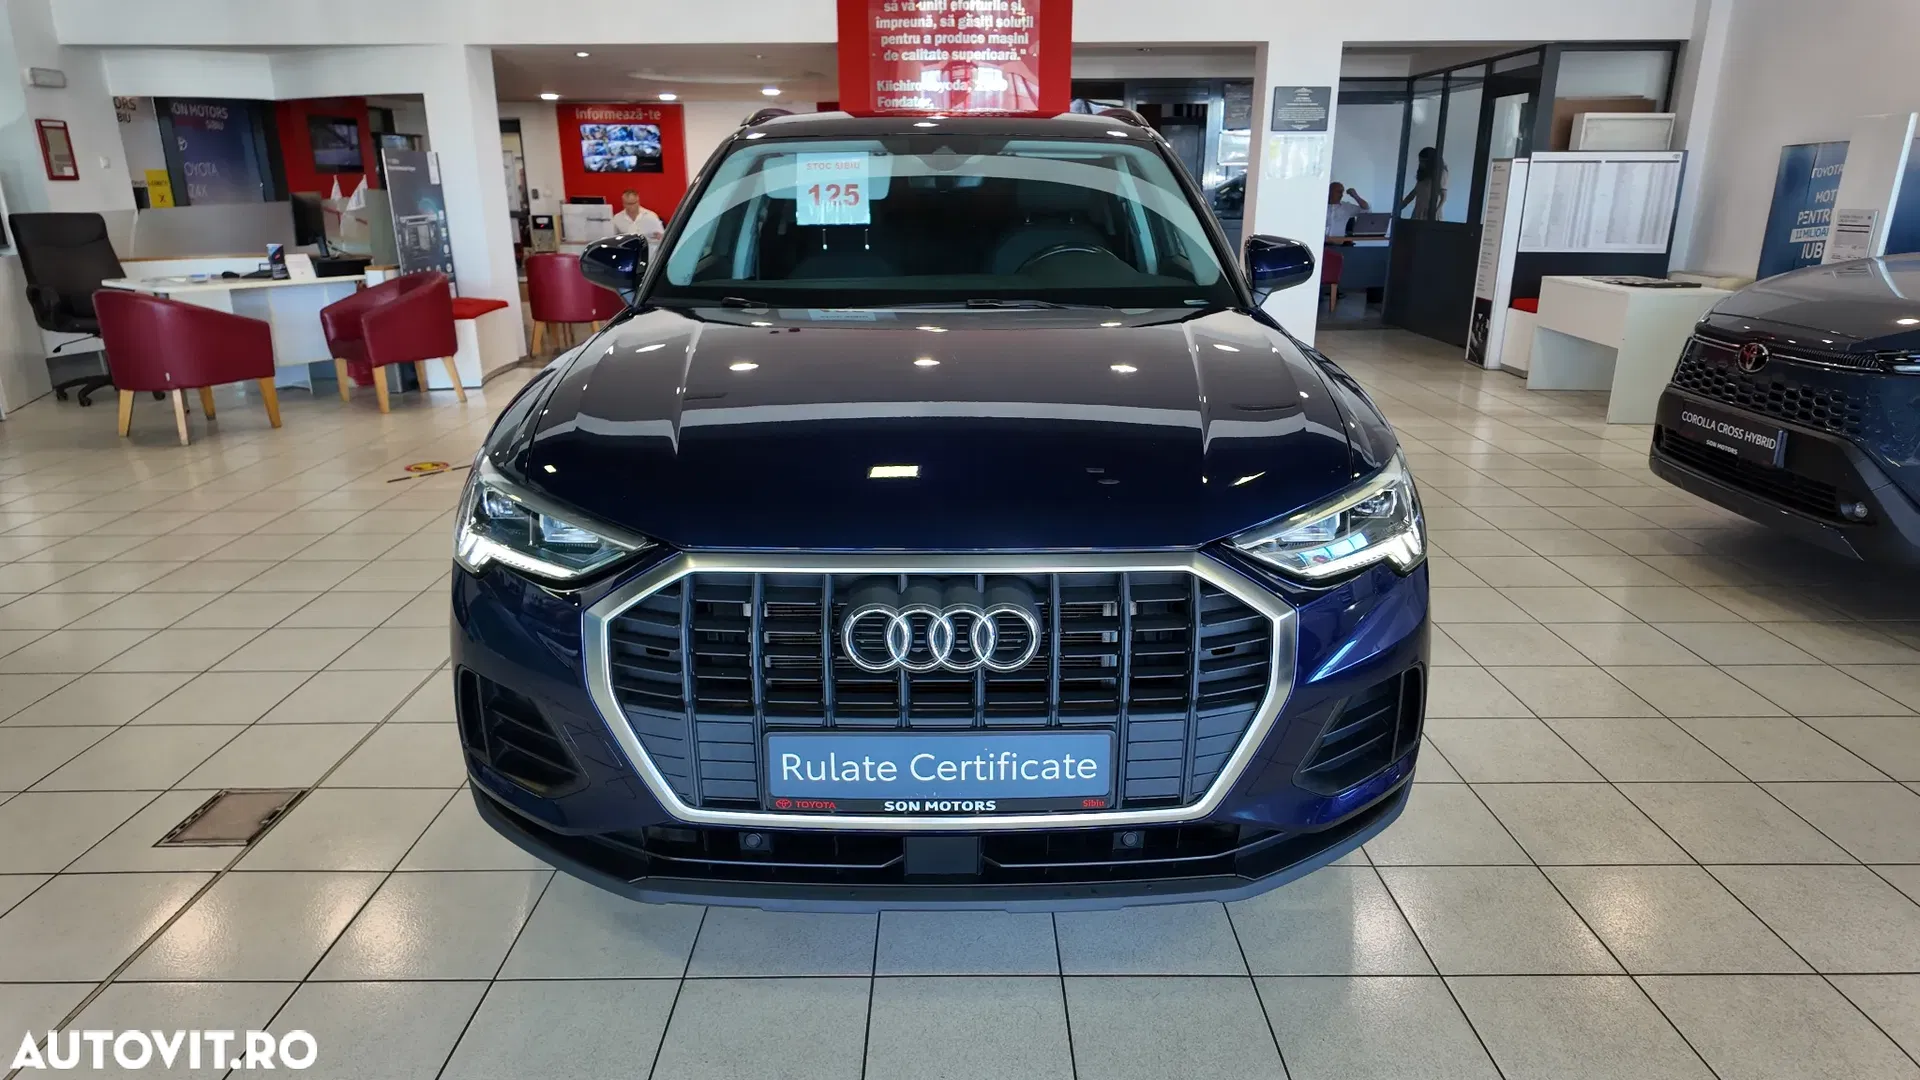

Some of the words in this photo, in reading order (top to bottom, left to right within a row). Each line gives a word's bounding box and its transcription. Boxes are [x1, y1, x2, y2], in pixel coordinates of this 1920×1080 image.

[940, 15, 955, 27] să
[881, 33, 920, 47] pentru
[923, 35, 931, 44] a
[935, 33, 985, 46] produce
[884, 50, 898, 61] de
[902, 49, 949, 61] calitate
[806, 162, 832, 170] STOC
[835, 161, 860, 169] SIBIU
[808, 183, 860, 206] 125
[1681, 411, 1716, 431] COROLLA
[1717, 422, 1745, 440] CROSS
[1744, 430, 1776, 450] HYBRID
[1706, 439, 1718, 449] SON
[1717, 443, 1738, 456] MOTORS
[781, 752, 898, 782] Rulate
[909, 751, 1098, 782] Certificate
[796, 801, 836, 809] TOYOTA
[884, 800, 920, 811] SON
[924, 800, 996, 811] MOTORS
